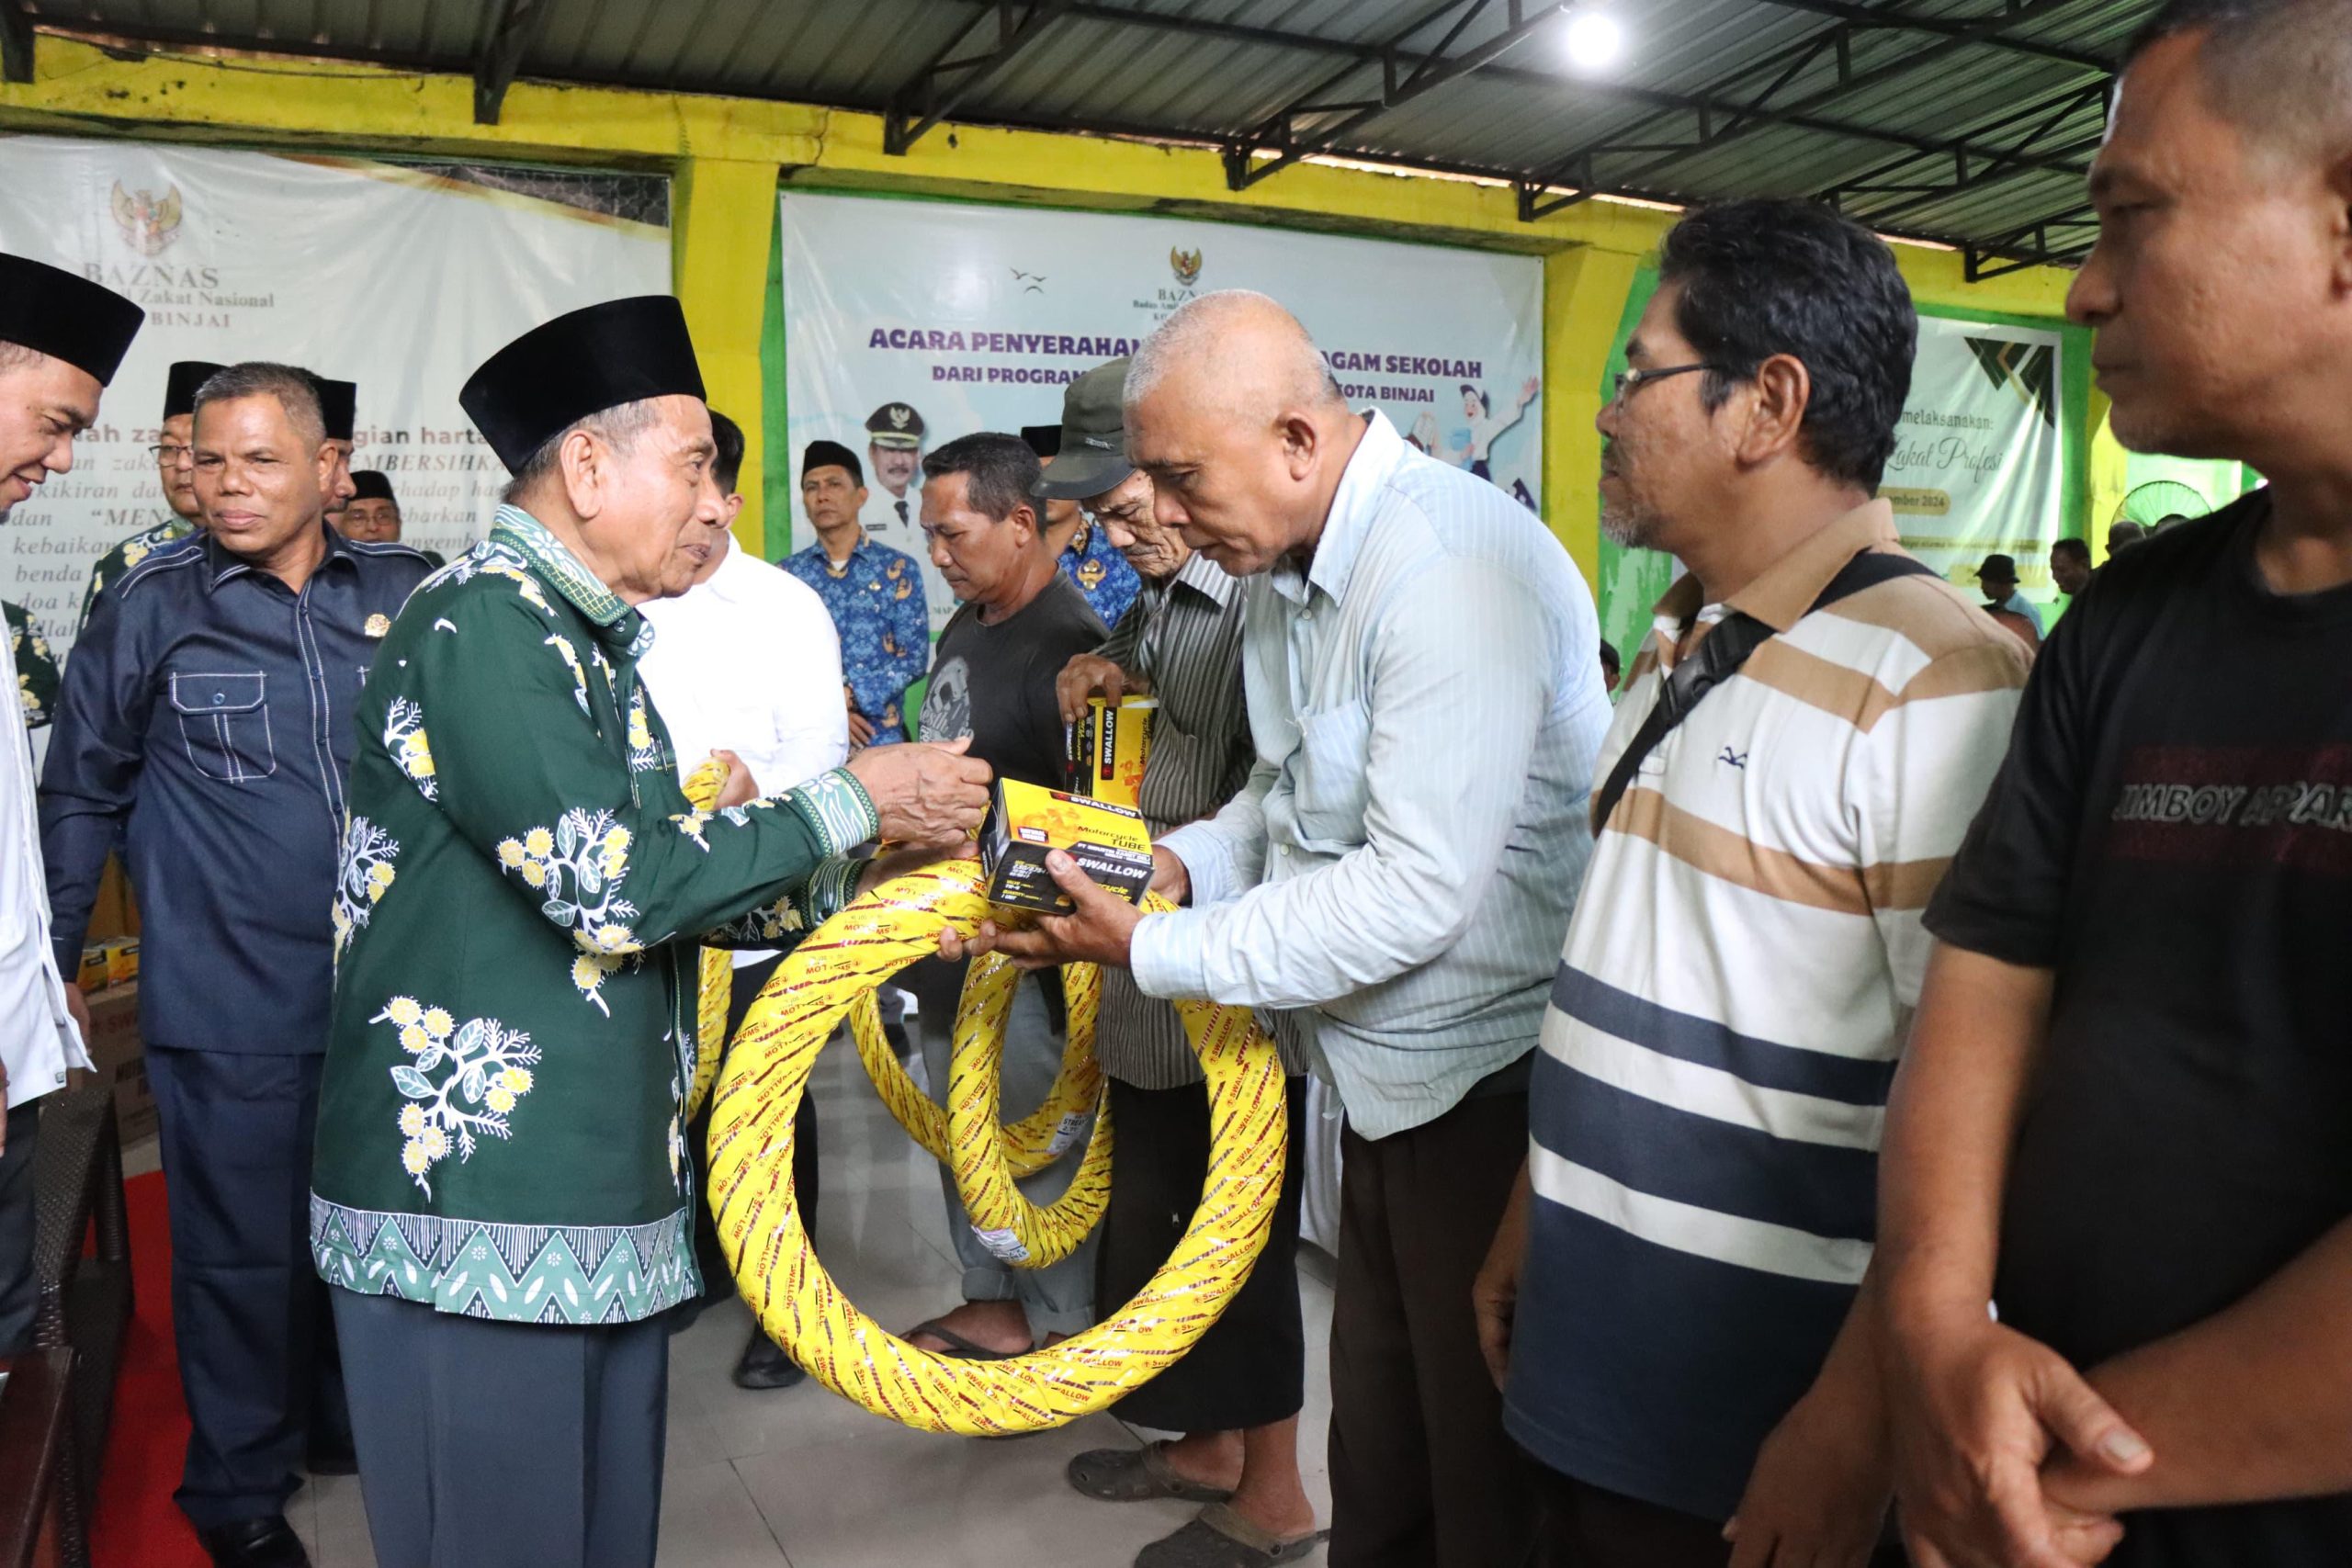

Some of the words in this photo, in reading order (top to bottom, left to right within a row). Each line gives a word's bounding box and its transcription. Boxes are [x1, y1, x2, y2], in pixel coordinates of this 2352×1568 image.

[85, 263, 220, 289] BAZNAS
[139, 289, 193, 306] Zakat
[199, 291, 275, 308] Nasional
[151, 311, 231, 328] BINJAI
[868, 328, 965, 351] ACARA
[1385, 355, 1482, 378] SEKOLAH
[932, 366, 982, 382] DARI
[1380, 386, 1434, 402] BINJAI
[1903, 410, 1994, 430] melaksanakan:
[11, 510, 52, 525] dan
[16, 564, 82, 582] benda
[1104, 710, 1114, 764] SWALLOW
[1139, 717, 1149, 765] Motorcycle
[1070, 796, 1136, 818] SWALLOW
[1078, 826, 1139, 842] Motorcycle
[1112, 839, 1146, 852] TUBE
[1077, 858, 1148, 879] SWALLOW
[1211, 1015, 1233, 1056] SWALLOW
